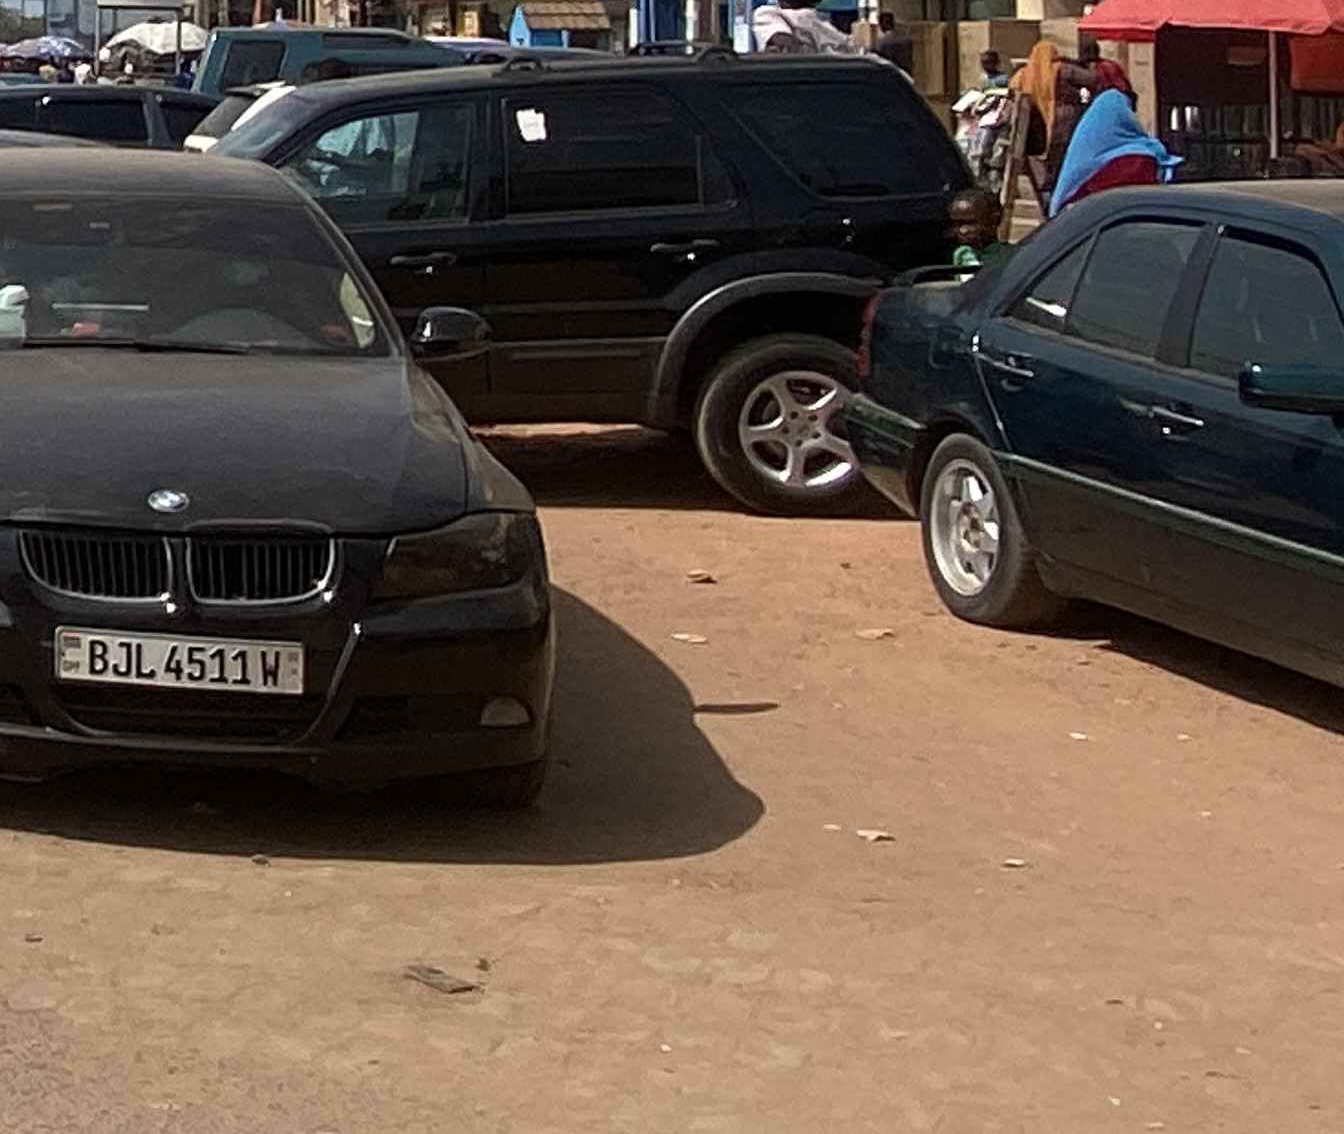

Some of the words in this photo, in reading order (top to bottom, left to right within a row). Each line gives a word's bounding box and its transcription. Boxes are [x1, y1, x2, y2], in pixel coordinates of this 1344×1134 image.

[88, 639, 157, 680] BJL
[164, 644, 252, 686] 4511
[259, 649, 281, 687] W
